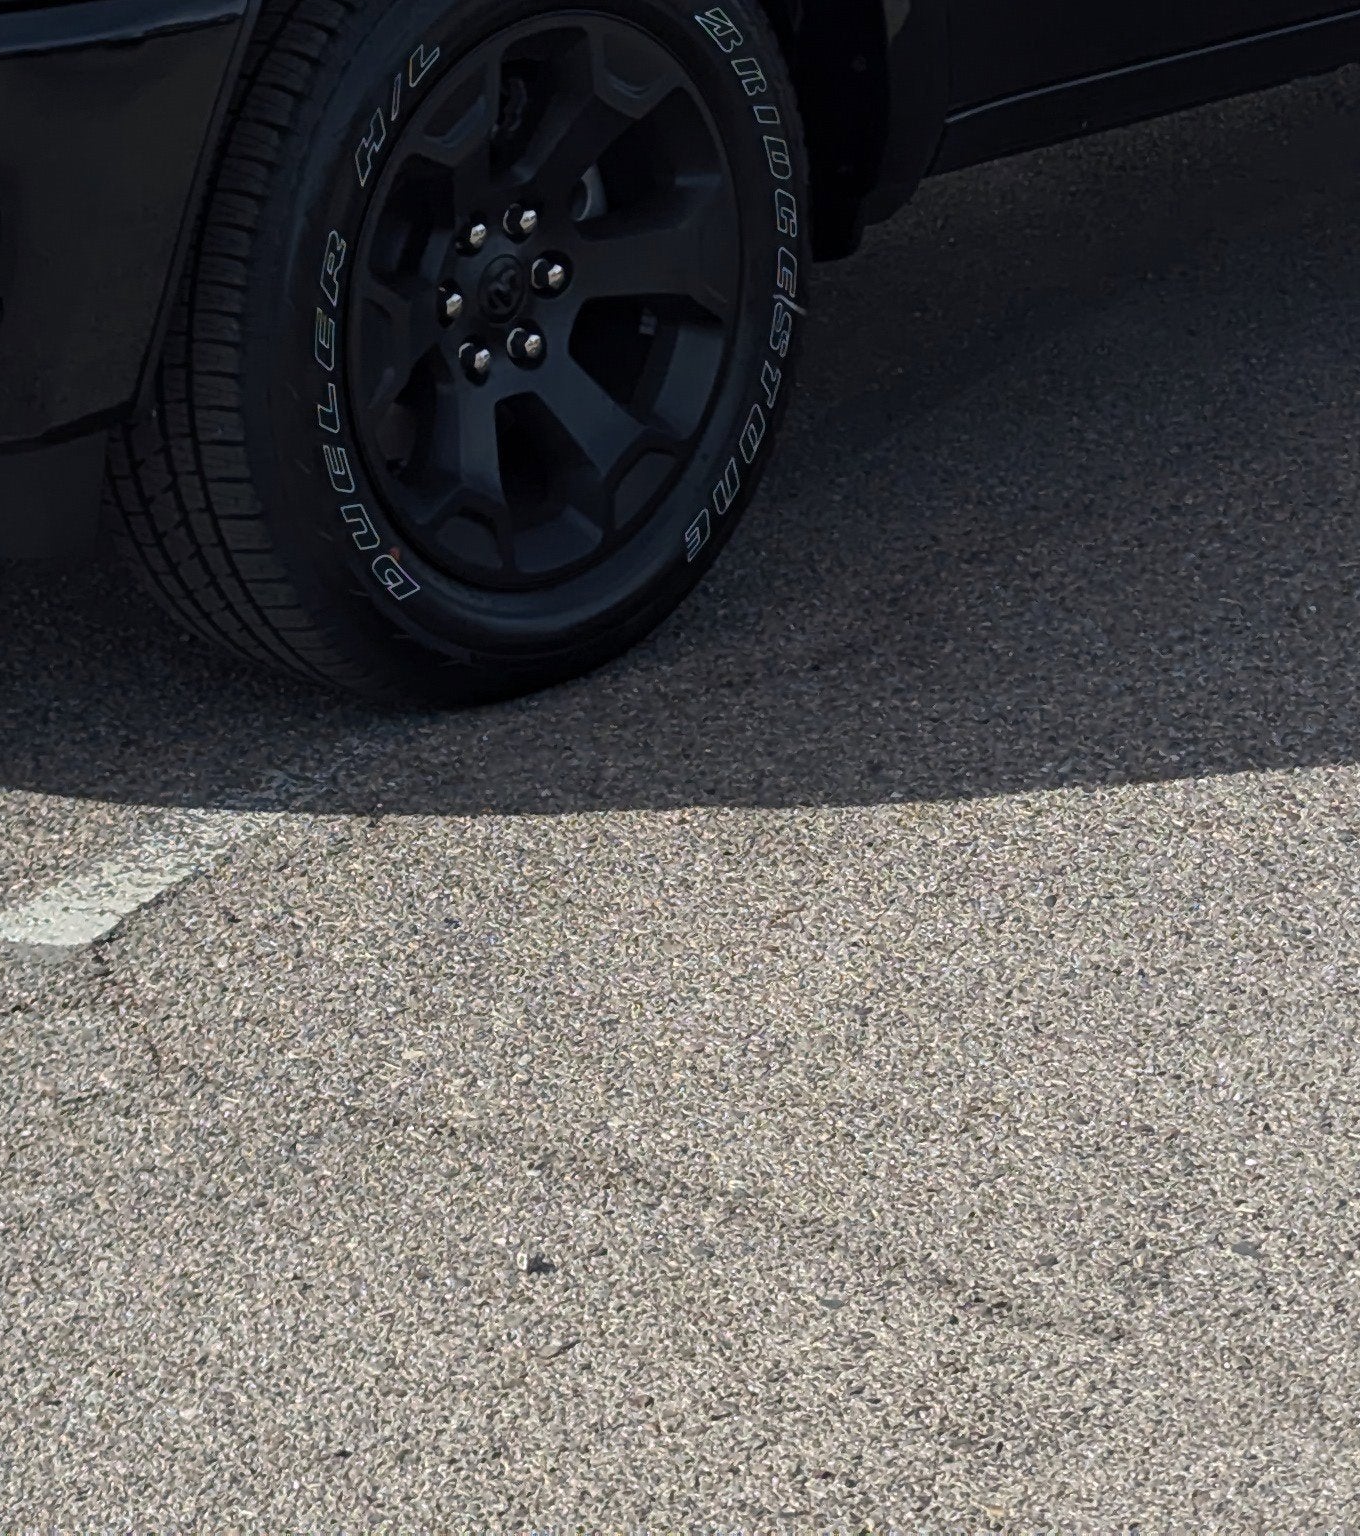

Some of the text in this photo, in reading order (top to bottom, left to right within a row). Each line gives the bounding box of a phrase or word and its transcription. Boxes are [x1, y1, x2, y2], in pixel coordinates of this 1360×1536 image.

[310, 43, 441, 602] DUELER H/L
[682, 5, 803, 564] BRIDGESTONE
